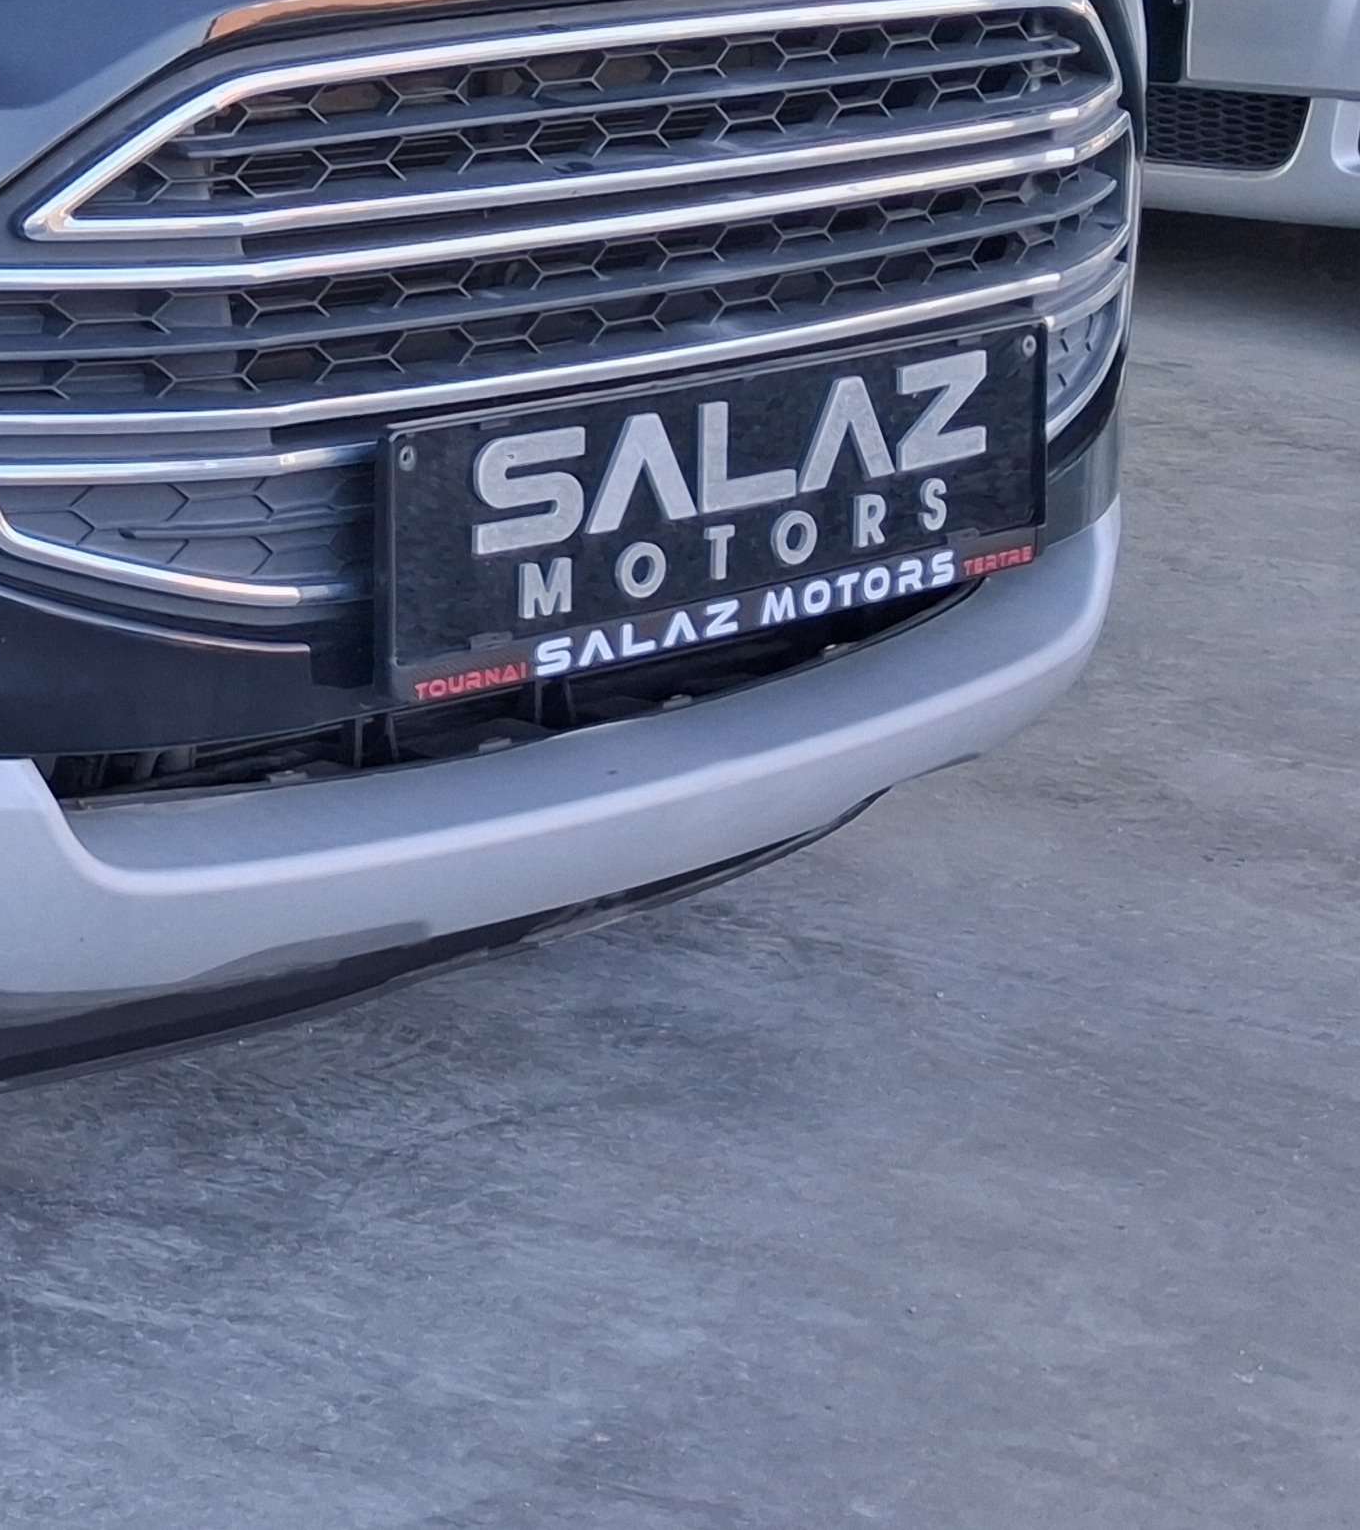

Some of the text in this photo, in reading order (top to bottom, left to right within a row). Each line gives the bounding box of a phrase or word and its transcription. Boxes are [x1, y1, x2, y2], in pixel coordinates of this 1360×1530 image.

[471, 349, 988, 556] SALAZ
[415, 545, 1033, 701] TOURNAI SALAZ MOTORS TERTRE
[518, 477, 949, 621] MOTORS
